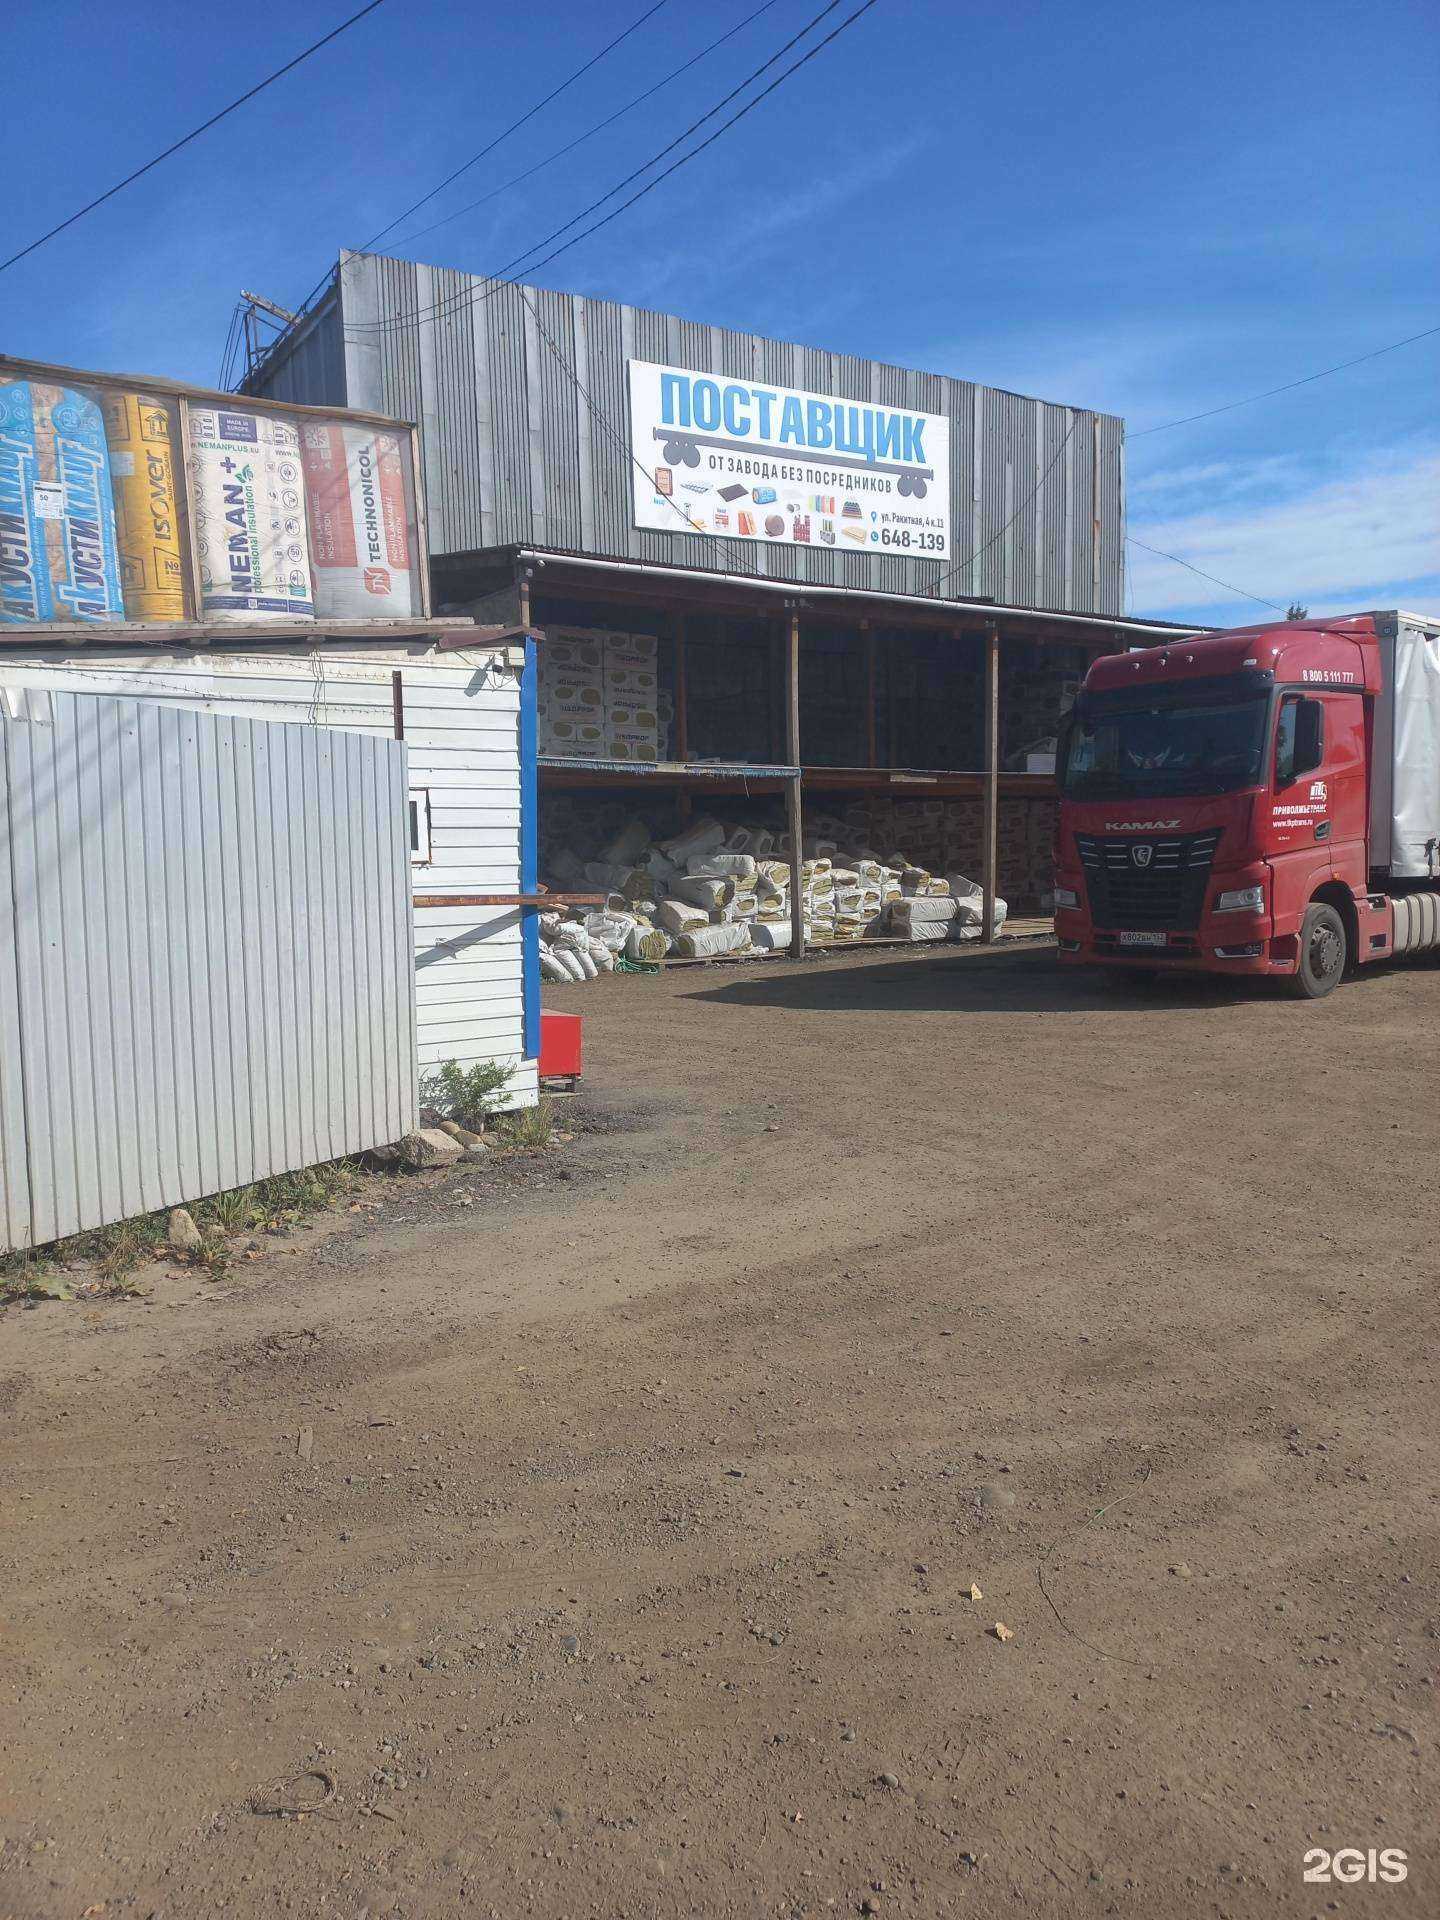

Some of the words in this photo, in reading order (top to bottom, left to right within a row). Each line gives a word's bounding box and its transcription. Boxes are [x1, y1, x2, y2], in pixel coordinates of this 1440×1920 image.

[660, 373, 927, 465] ПОСТАВЩИК
[708, 454, 724, 471] ОТ
[727, 457, 778, 479] ЗАВОДА
[781, 465, 803, 482] БЕЗ
[806, 468, 892, 494] ПОСРЕДНИКОВ
[358, 445, 382, 563] TECHNONICOL
[881, 512, 891, 524] ул.
[892, 512, 925, 528] Ракитная,
[881, 527, 945, 551] 648-139
[1302, 669, 1308, 682] 8
[1308, 669, 1323, 683] 800
[1323, 670, 1329, 683] 5
[1329, 670, 1341, 684] 111
[1341, 671, 1354, 684] 777
[1105, 819, 1182, 831] KAMAZ
